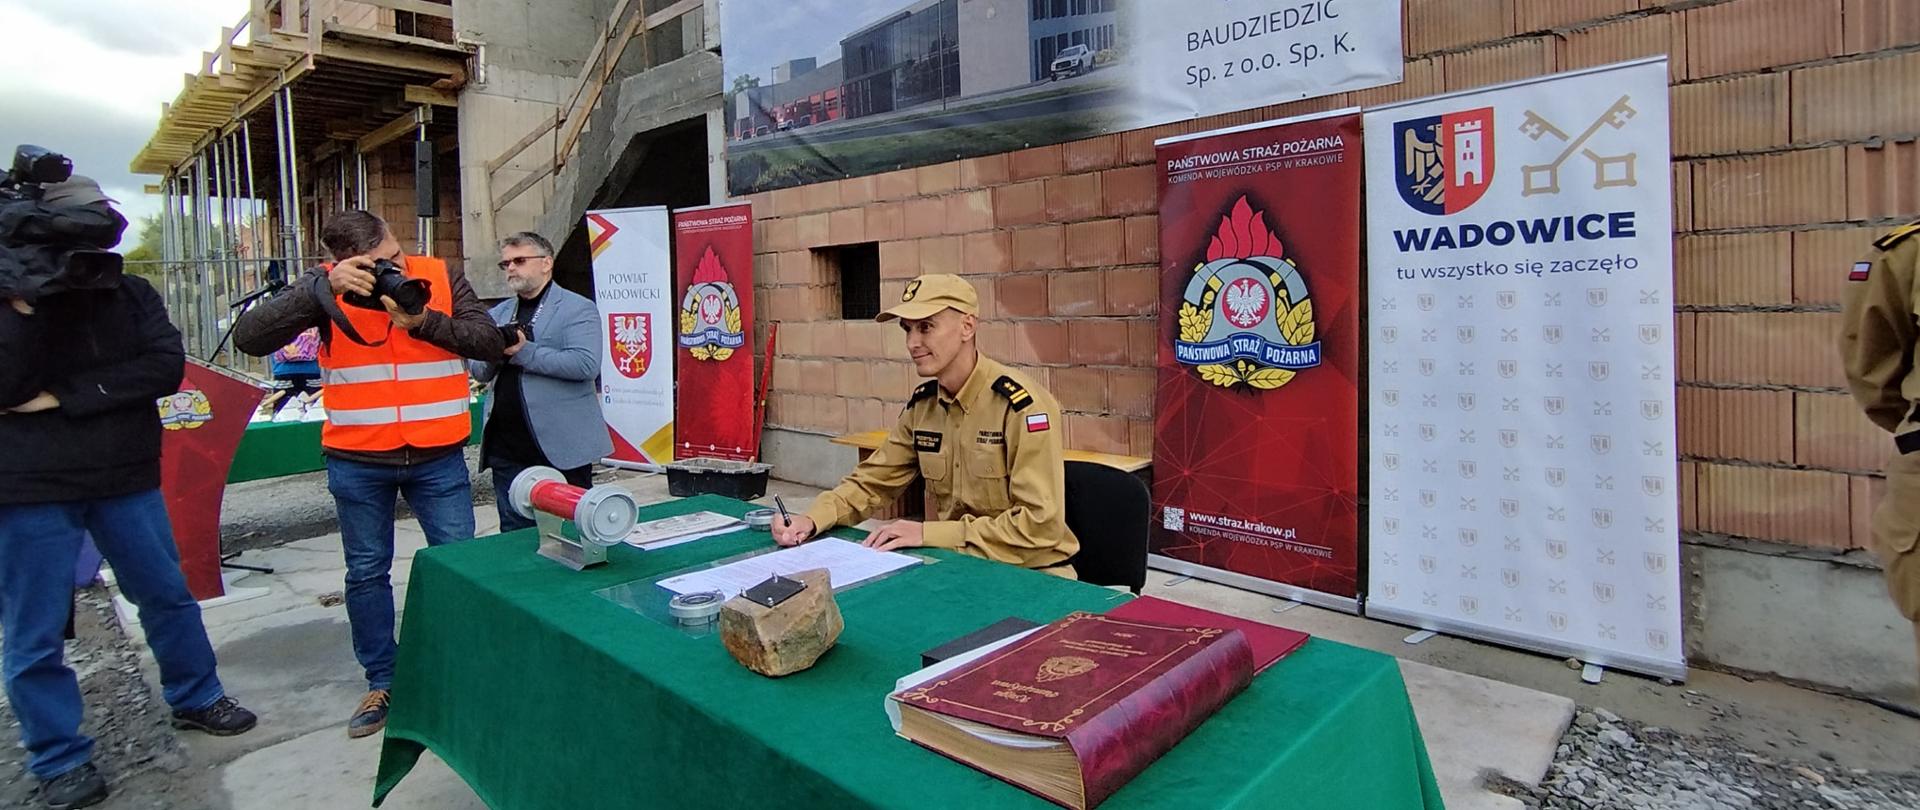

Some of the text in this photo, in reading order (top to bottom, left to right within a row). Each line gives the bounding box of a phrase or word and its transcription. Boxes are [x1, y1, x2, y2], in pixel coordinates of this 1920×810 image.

[1186, 32, 1356, 88] Sp. z o.o. Sp. K.
[1167, 135, 1344, 171] PAŃSTWOWA STRAŻ POŻARNA
[1168, 153, 1343, 184] KOMENDA WOJEWÓDZKA PSP W KRAKOWIE
[1393, 211, 1637, 253] WADOWICE
[1397, 253, 1639, 280] tu wszystko się zaczęło
[598, 272, 661, 300] POWIAT WADOWICKI
[1177, 335, 1316, 364] PAŃSTWOWA STRAŻ POŻARNA
[1189, 511, 1296, 539] www.straz.krakow.pl
[1189, 526, 1221, 538] KOMENDA
[1222, 531, 1269, 547] WOJEWÓDZKA
[1270, 540, 1284, 550] PSP
[1294, 545, 1333, 559] KRAKOWIE
